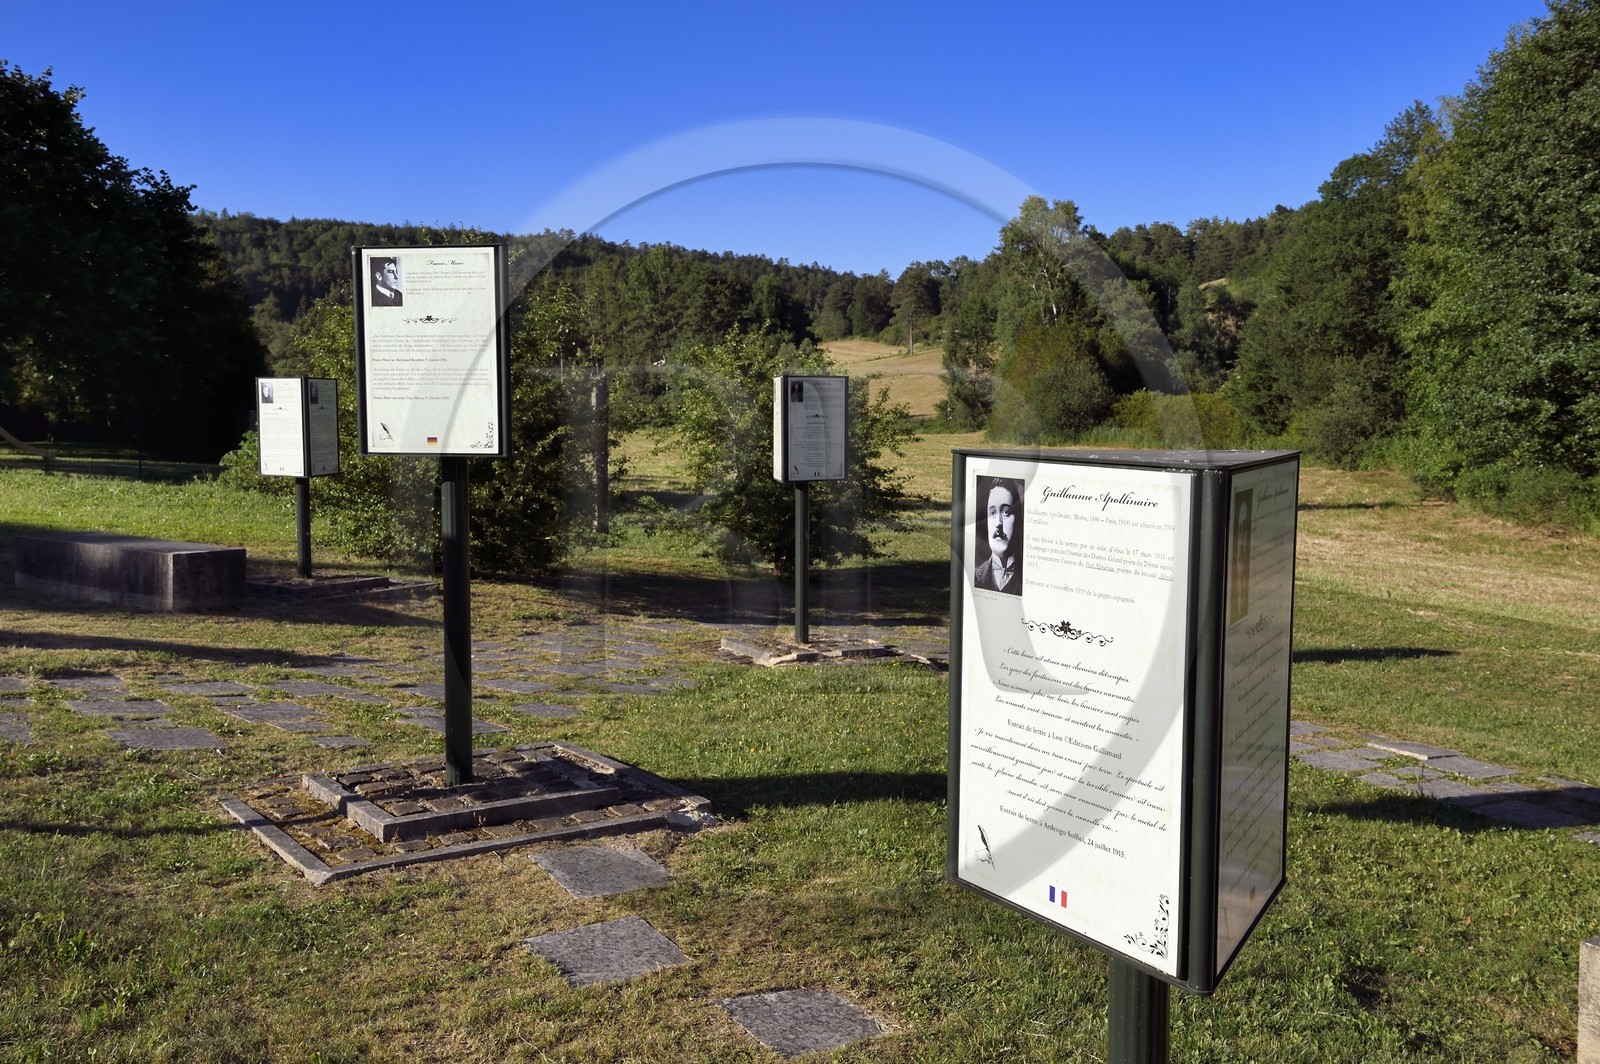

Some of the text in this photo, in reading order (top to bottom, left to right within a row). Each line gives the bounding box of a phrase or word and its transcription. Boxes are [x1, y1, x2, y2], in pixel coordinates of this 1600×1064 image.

[1040, 484, 1158, 512] Guillaume Apollinaire
[1008, 719, 1025, 730] Extrait
[1033, 727, 1046, 736] lettre
[1052, 732, 1063, 742] Lou
[1093, 745, 1122, 760] Gallimard
[1000, 805, 1017, 816] Extrait
[1025, 814, 1038, 825] lettre
[1043, 822, 1067, 836] Ardengo
[1095, 843, 1111, 853] juillet
